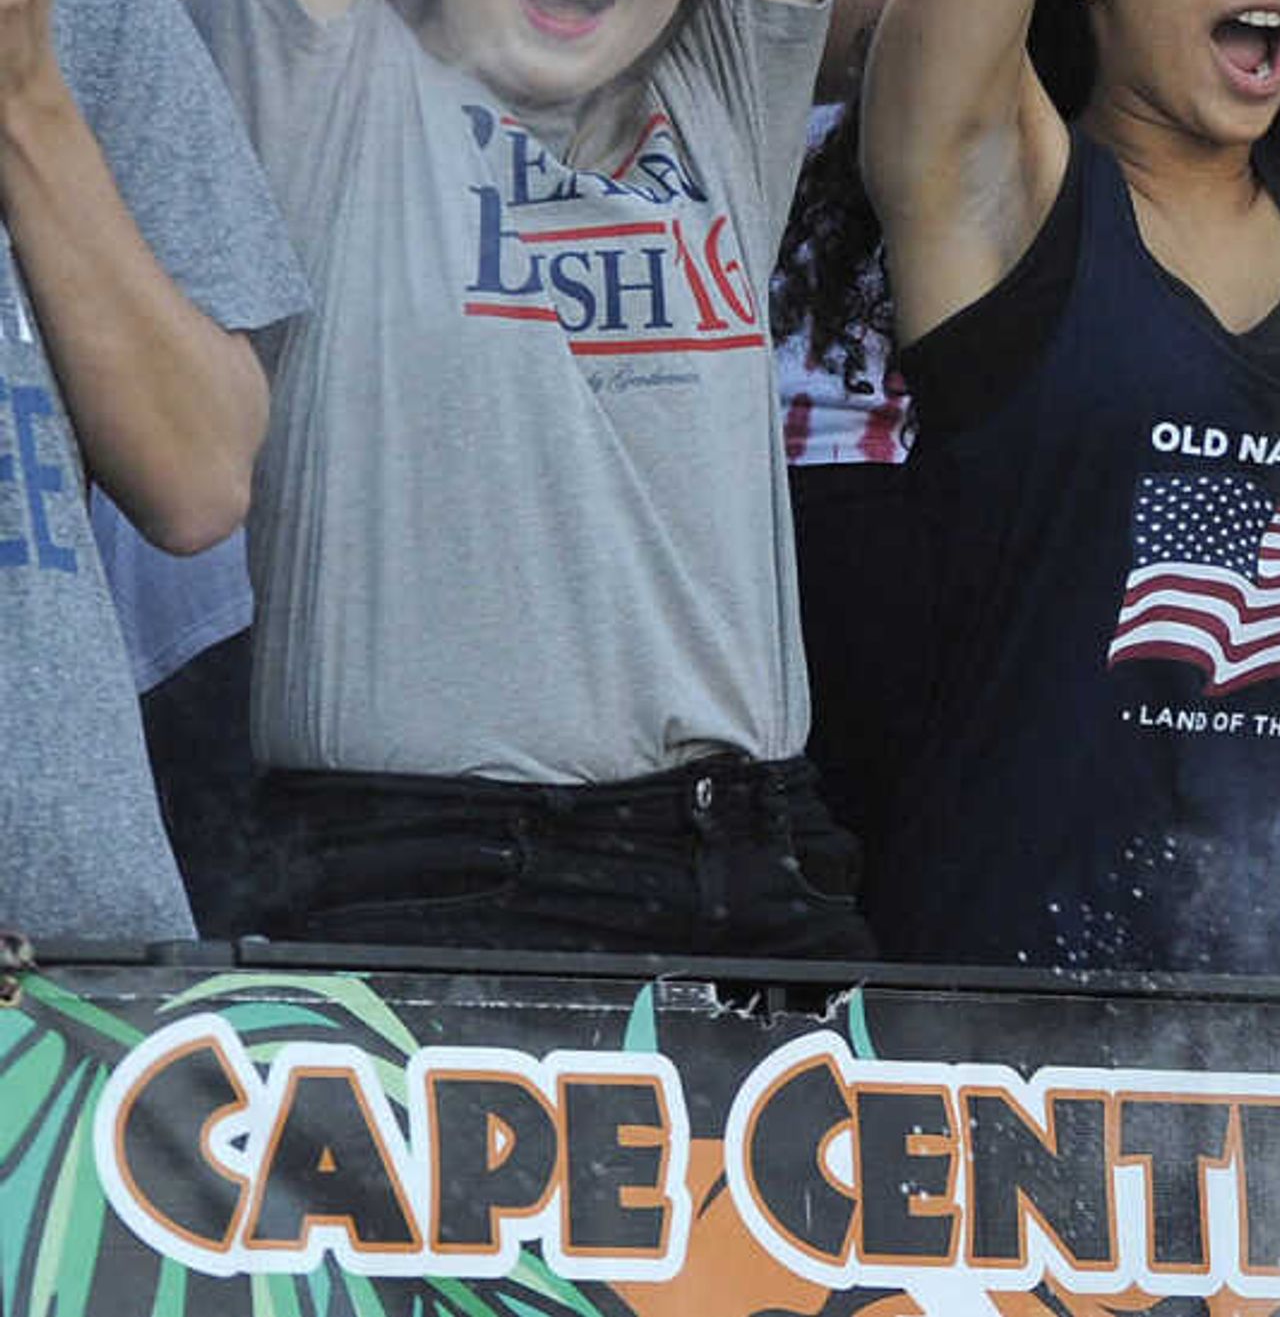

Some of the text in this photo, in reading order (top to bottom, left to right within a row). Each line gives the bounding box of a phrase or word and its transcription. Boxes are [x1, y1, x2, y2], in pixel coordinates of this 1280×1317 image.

[1151, 422, 1228, 458] OLD
[1139, 704, 1207, 732] LAND
[1213, 712, 1244, 733] OF
[94, 1014, 688, 1276] CAPE
